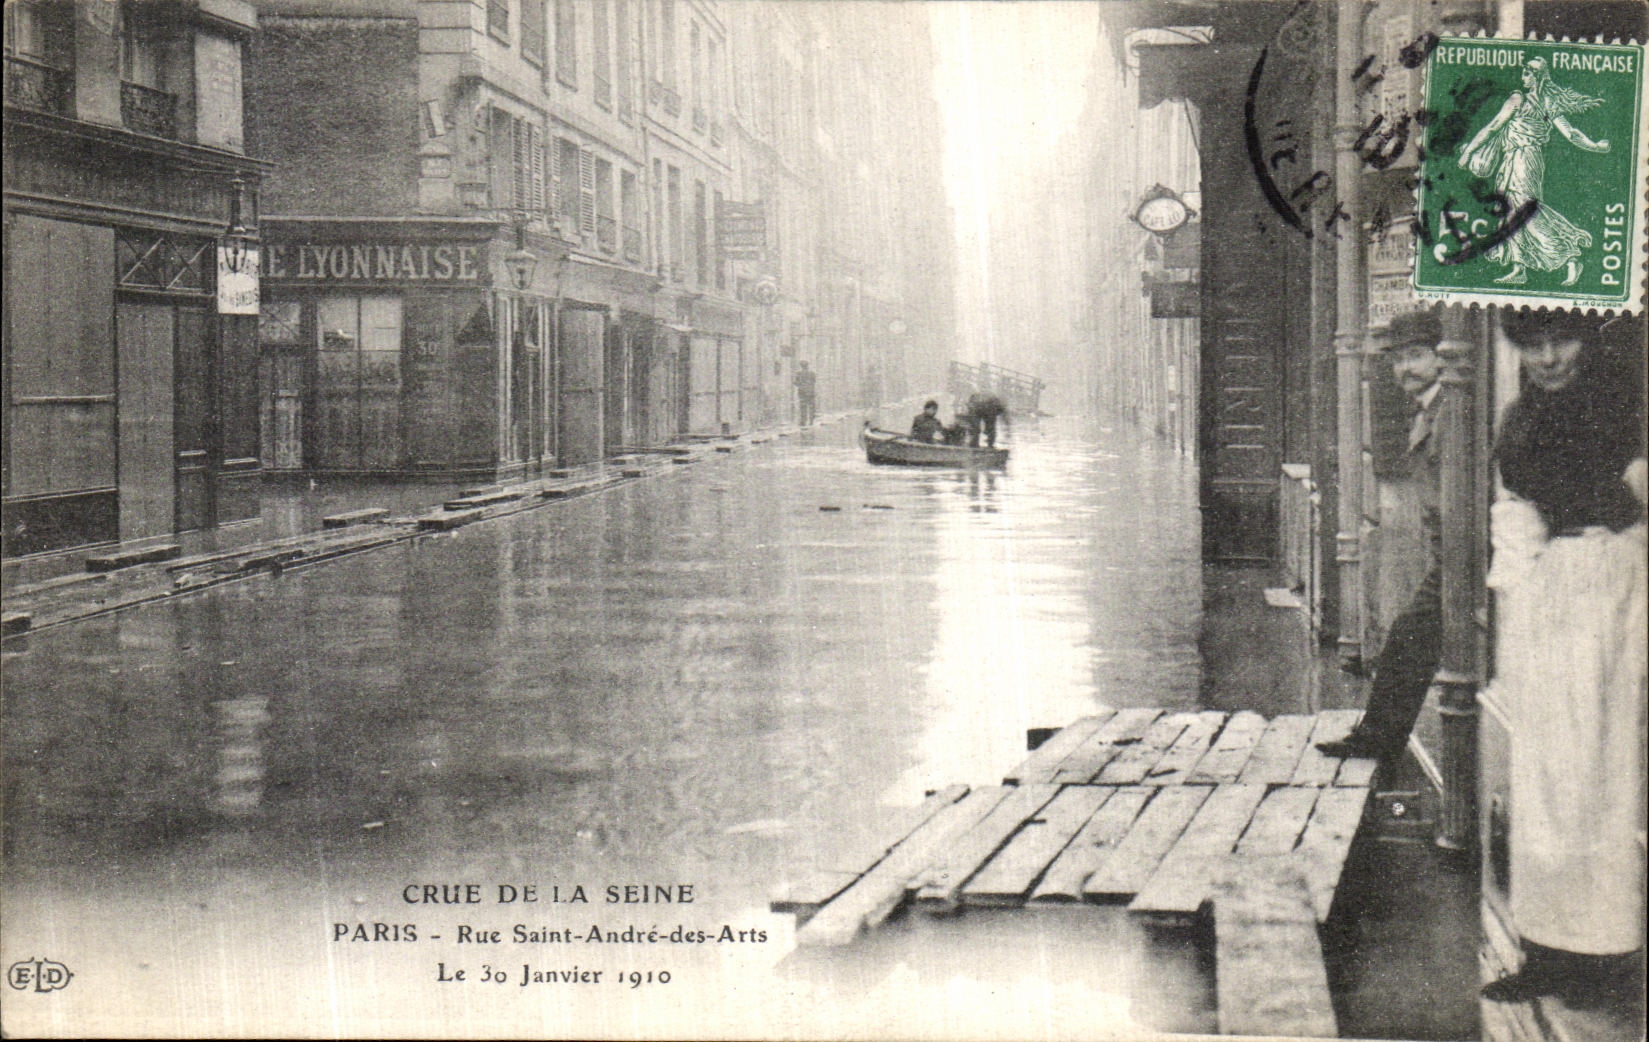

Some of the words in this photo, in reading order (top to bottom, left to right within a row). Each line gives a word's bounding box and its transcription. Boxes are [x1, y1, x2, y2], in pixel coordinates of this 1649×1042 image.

[1436, 45, 1525, 70] REPUBLIQUE
[1552, 51, 1634, 74] FRANÇAISE
[1601, 203, 1625, 286] POSTES
[297, 245, 478, 279] LYONNAISE
